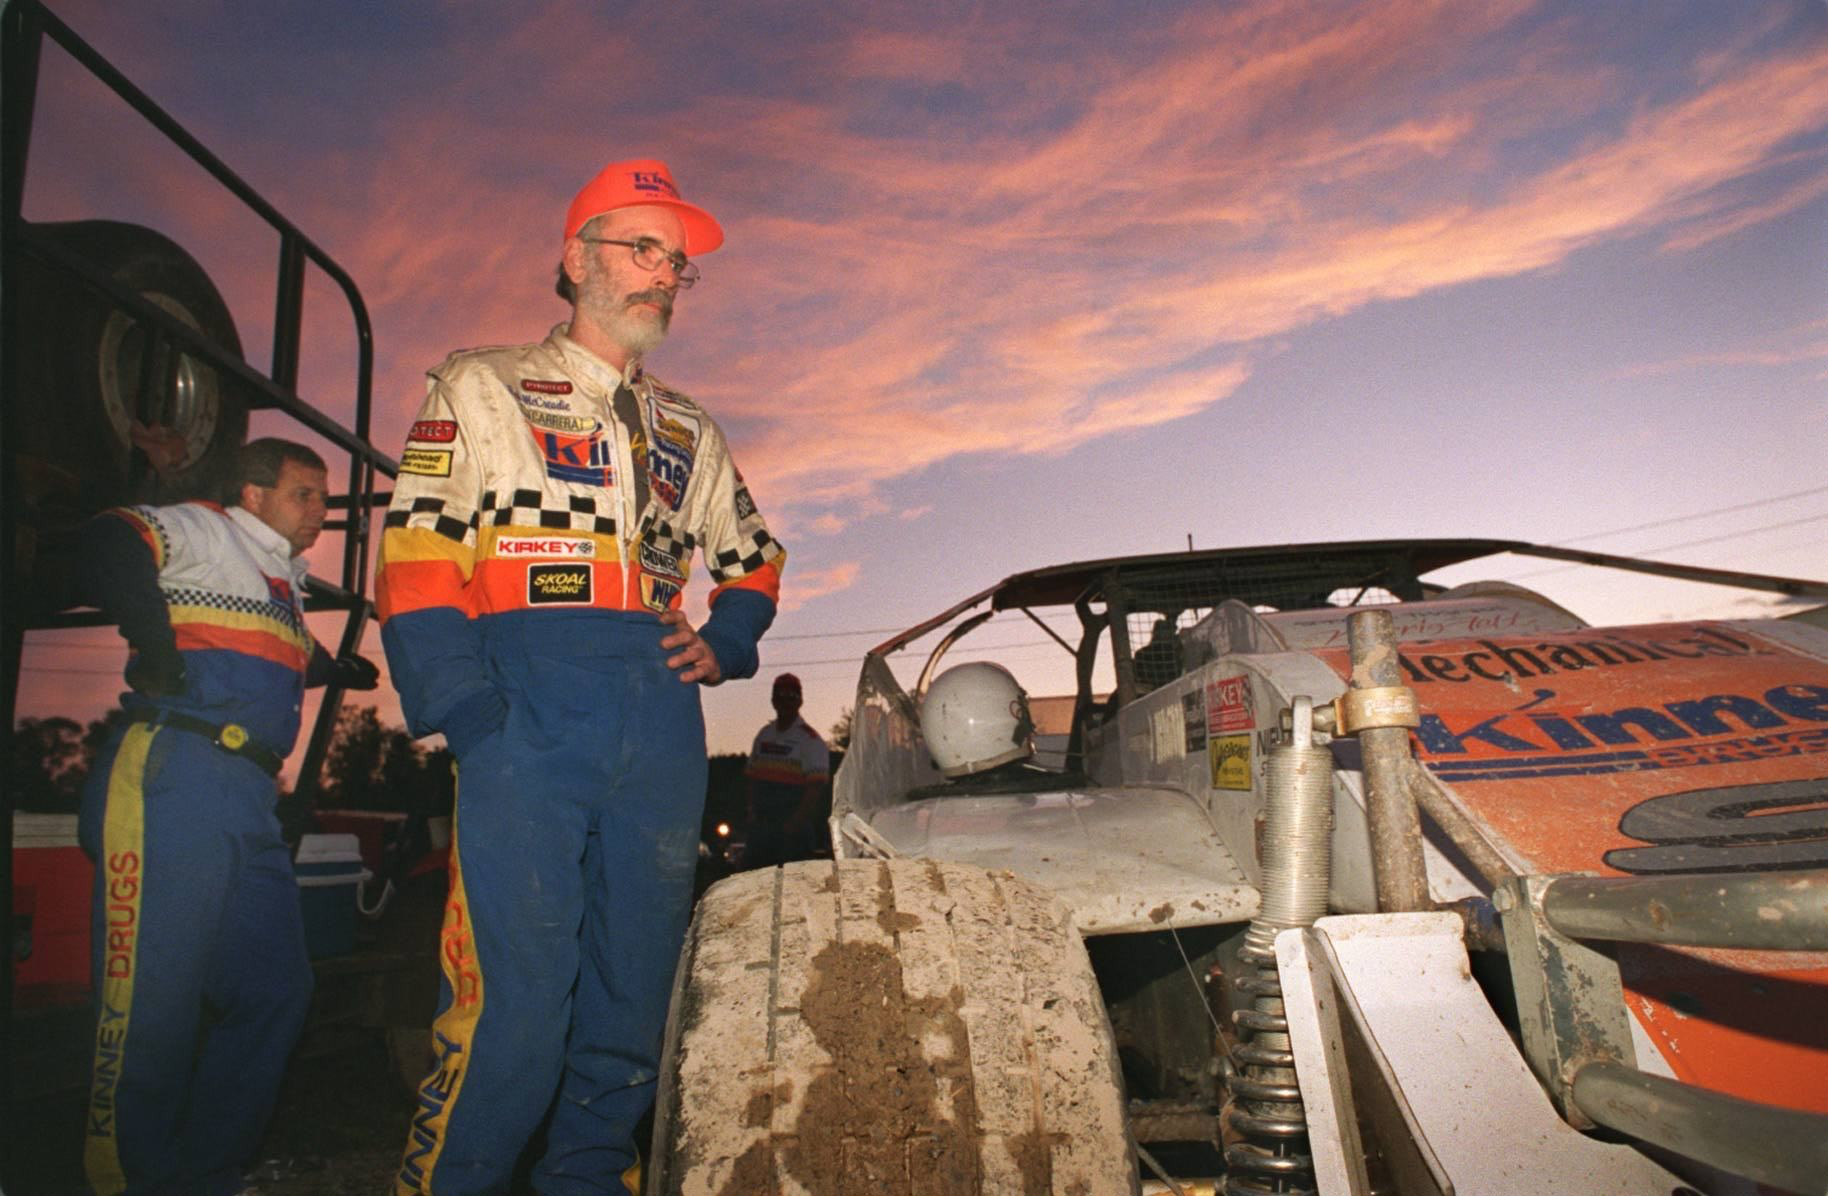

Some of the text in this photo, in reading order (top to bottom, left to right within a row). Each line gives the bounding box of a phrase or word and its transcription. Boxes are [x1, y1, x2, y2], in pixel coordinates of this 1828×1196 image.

[499, 540, 577, 554] KIRKEY
[534, 573, 587, 586] SKOAL
[541, 585, 580, 594] RACING
[88, 850, 140, 1138] KINNEY DRUGS
